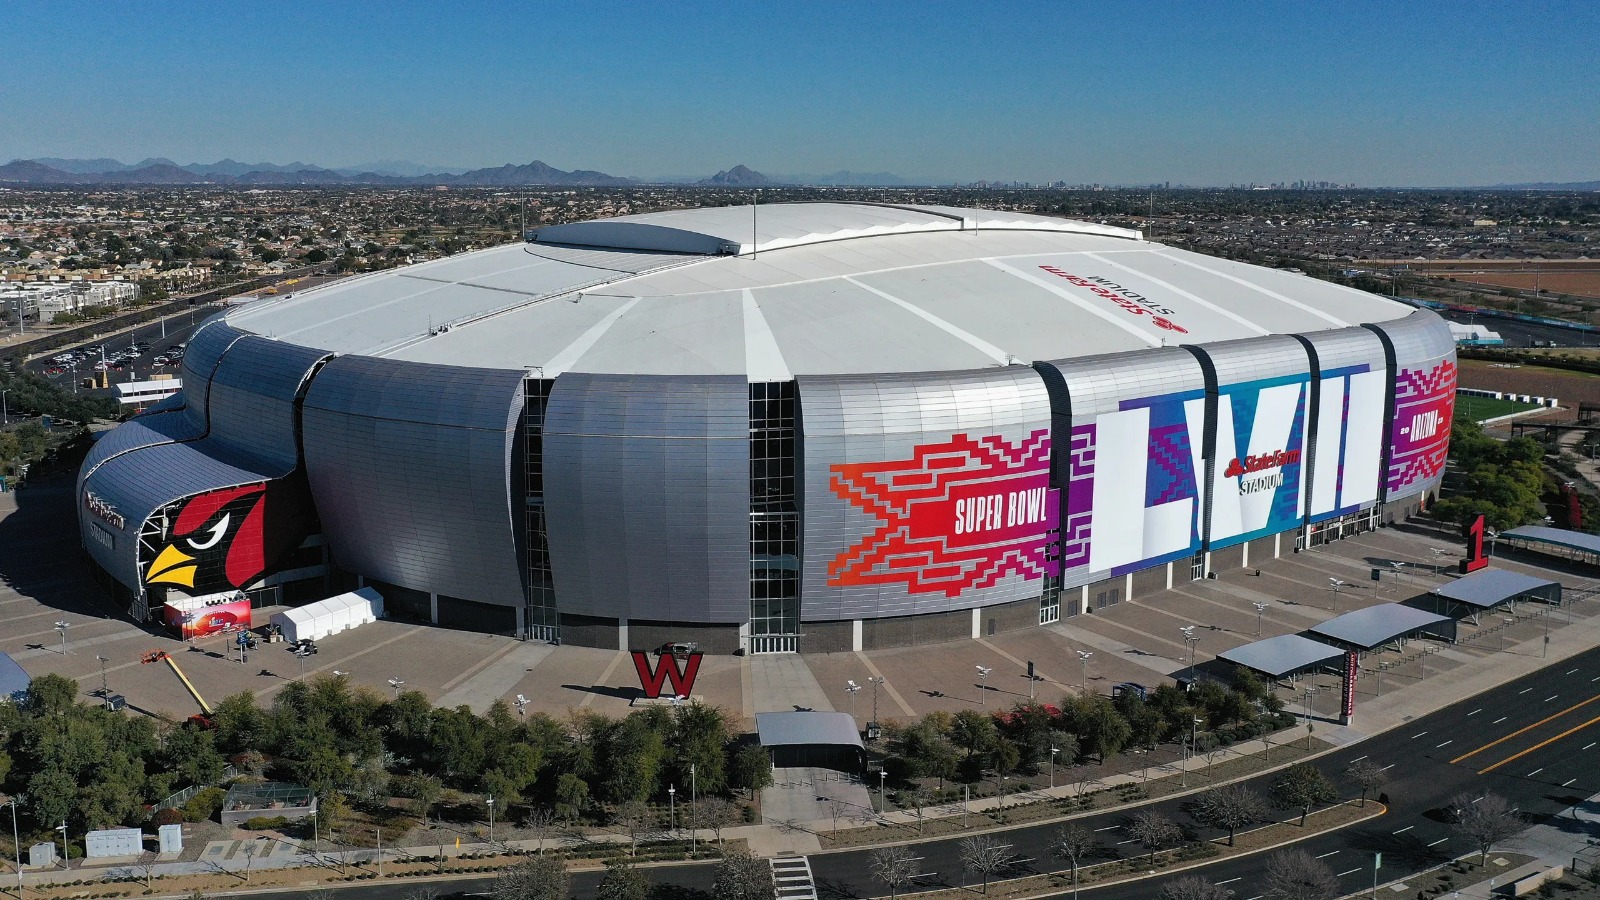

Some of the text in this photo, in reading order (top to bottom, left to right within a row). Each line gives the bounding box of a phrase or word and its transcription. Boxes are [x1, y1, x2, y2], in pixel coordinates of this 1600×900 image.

[1086, 275, 1175, 316] STADIUM
[1410, 409, 1439, 443] ARIZONA
[1239, 472, 1284, 496] STADIUM
[954, 486, 1047, 535] SUPER BOWL
[1464, 513, 1489, 574] 1
[630, 649, 704, 700] W
